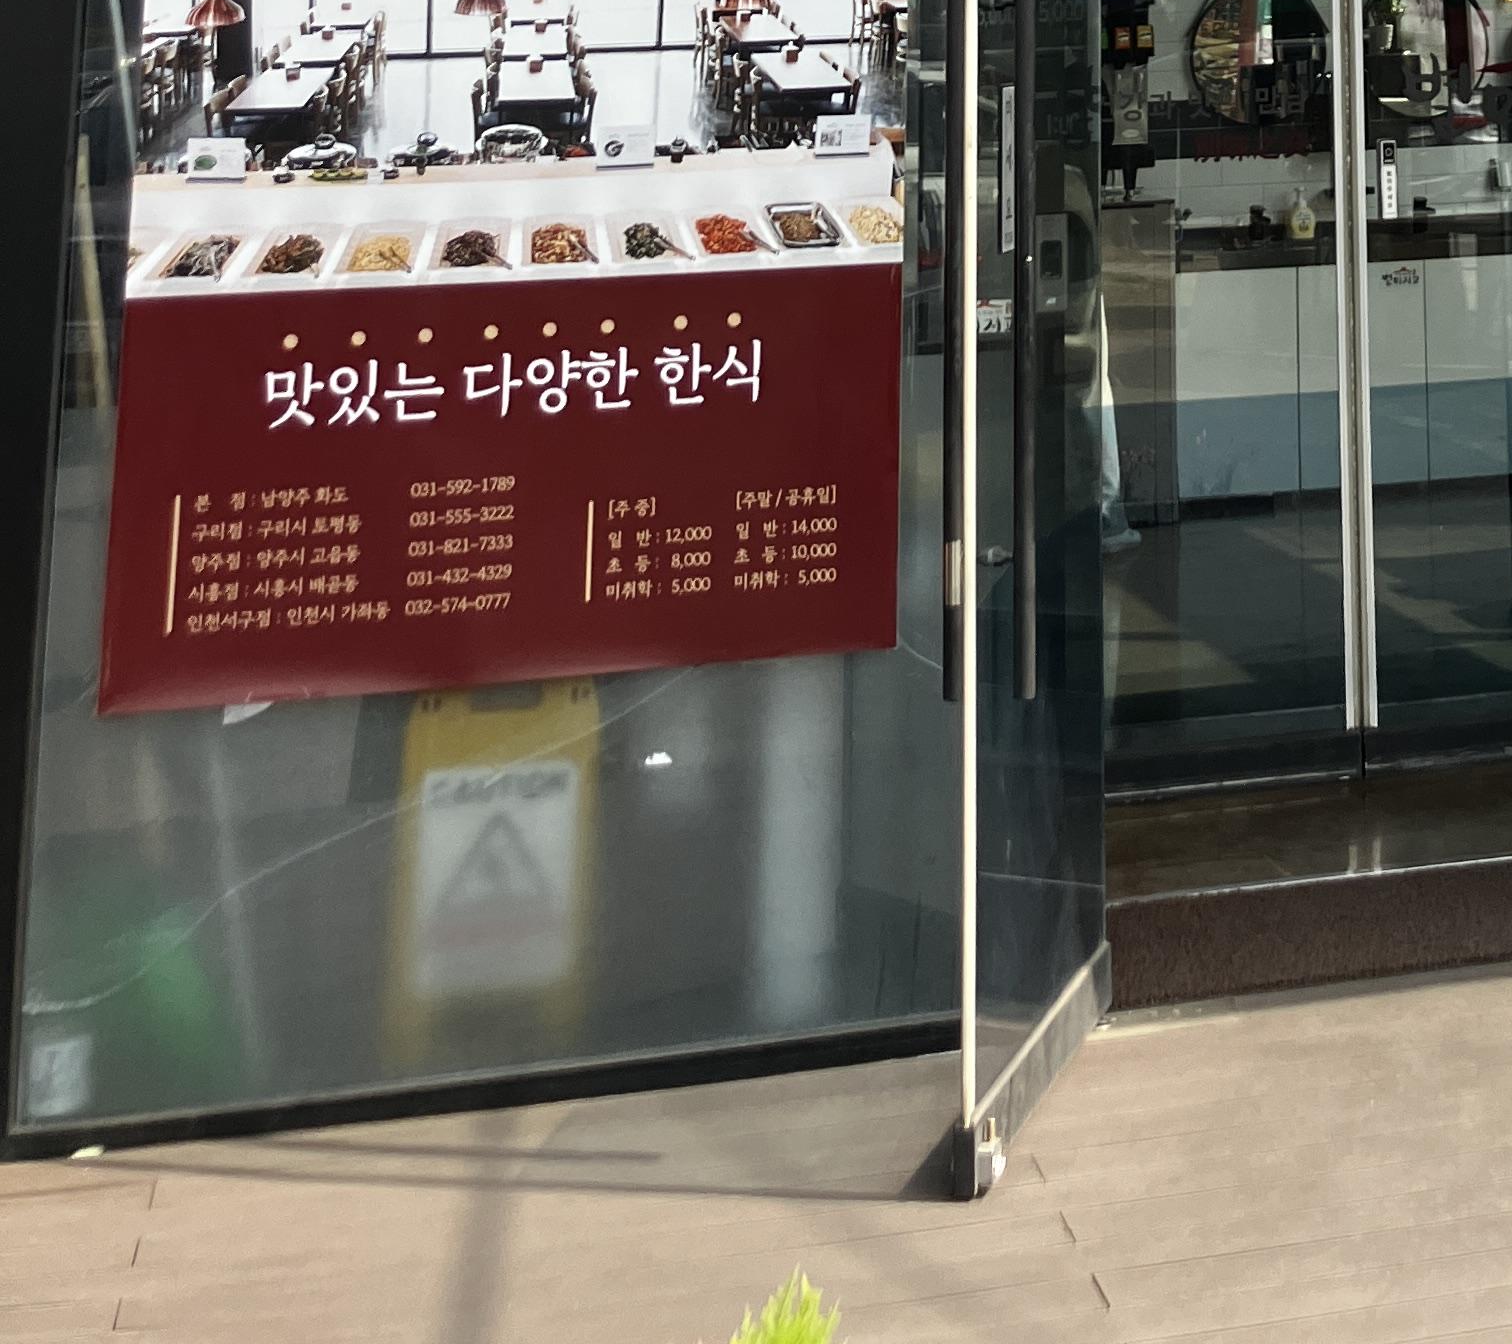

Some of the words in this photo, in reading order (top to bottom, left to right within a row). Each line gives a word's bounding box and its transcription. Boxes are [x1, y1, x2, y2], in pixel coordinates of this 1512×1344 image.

[263, 359, 445, 429] 맛있는
[462, 347, 639, 416] 다양한
[654, 338, 763, 407] 한식
[410, 475, 516, 498] 031-592-1789
[409, 504, 515, 528] 031-555-3222
[790, 517, 838, 536] 14,000
[408, 533, 514, 557] 031-821-7333
[665, 526, 713, 545] 12,000
[670, 551, 712, 571] 8,000
[790, 542, 838, 561] 10,000
[406, 563, 513, 587] 031-432-4329
[798, 567, 837, 587] 5,000
[671, 577, 712, 596] 5,000
[404, 592, 511, 616] 032-574-0777
